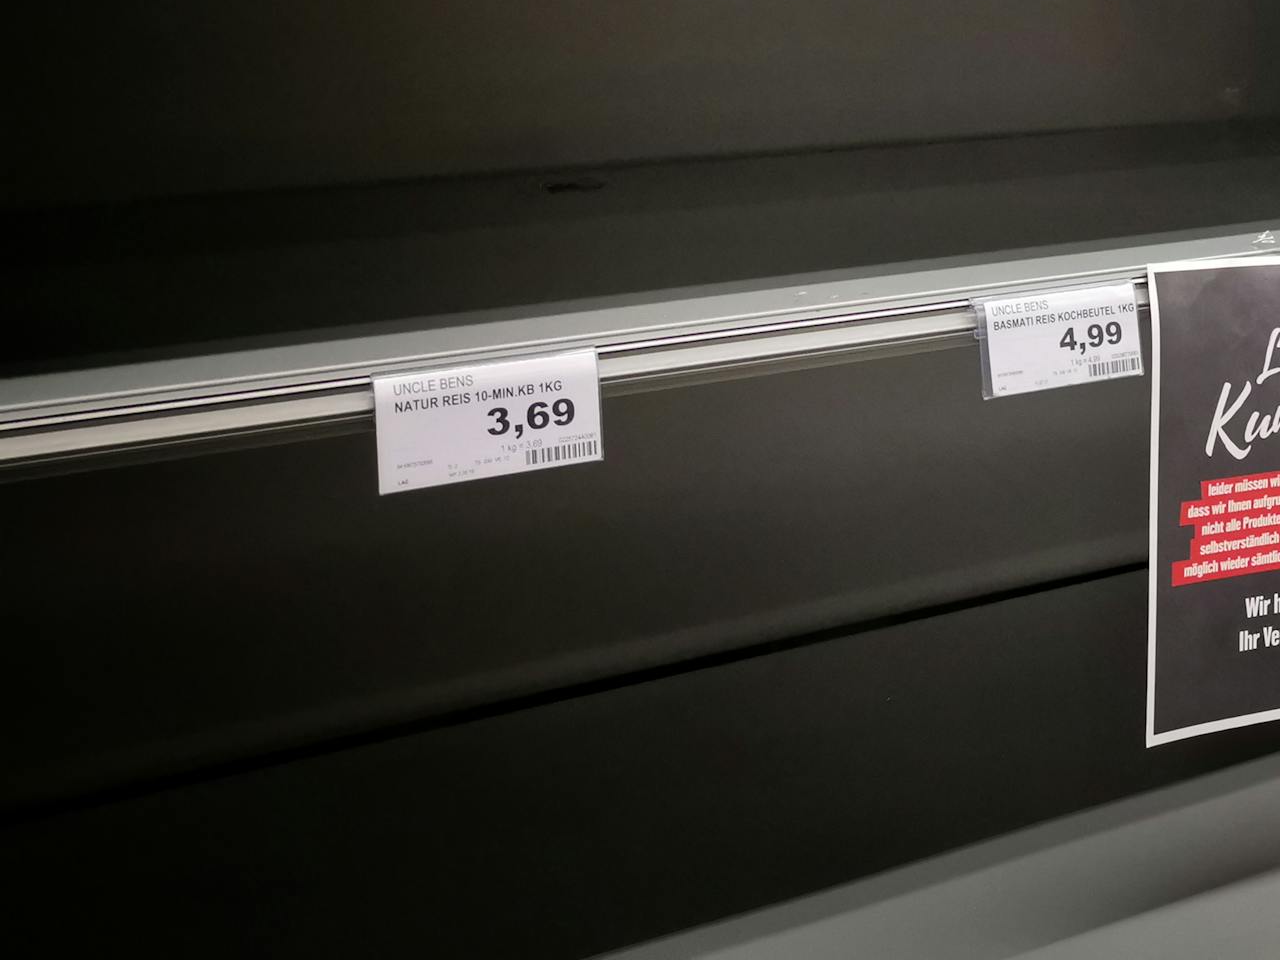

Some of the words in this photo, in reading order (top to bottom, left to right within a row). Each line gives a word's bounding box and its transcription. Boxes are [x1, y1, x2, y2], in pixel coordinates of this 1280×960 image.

[994, 316, 1034, 331] BASMATI
[1036, 313, 1056, 324] REIS
[1058, 306, 1116, 322] KOCHBEUTEL
[1118, 302, 1135, 314] 1KG
[1059, 321, 1122, 355] 4,99
[394, 396, 439, 414] NATUR
[443, 394, 471, 406] REIS
[475, 384, 535, 402] 10-MIN.KB
[539, 380, 562, 392] 1KG
[487, 398, 575, 440] 3,69
[1208, 481, 1234, 496] leider
[1234, 477, 1268, 494] müssen
[1188, 502, 1210, 518] dass
[1212, 501, 1226, 514] wir
[1228, 498, 1252, 513] Ihnen
[1202, 520, 1224, 536] nicht
[1226, 518, 1242, 532] alle
[1200, 531, 1280, 556] selbstverständlich
[1184, 560, 1219, 578] möglich
[1220, 556, 1250, 572] wieder
[1245, 596, 1272, 618] Wir
[1239, 629, 1260, 652] Ihr
